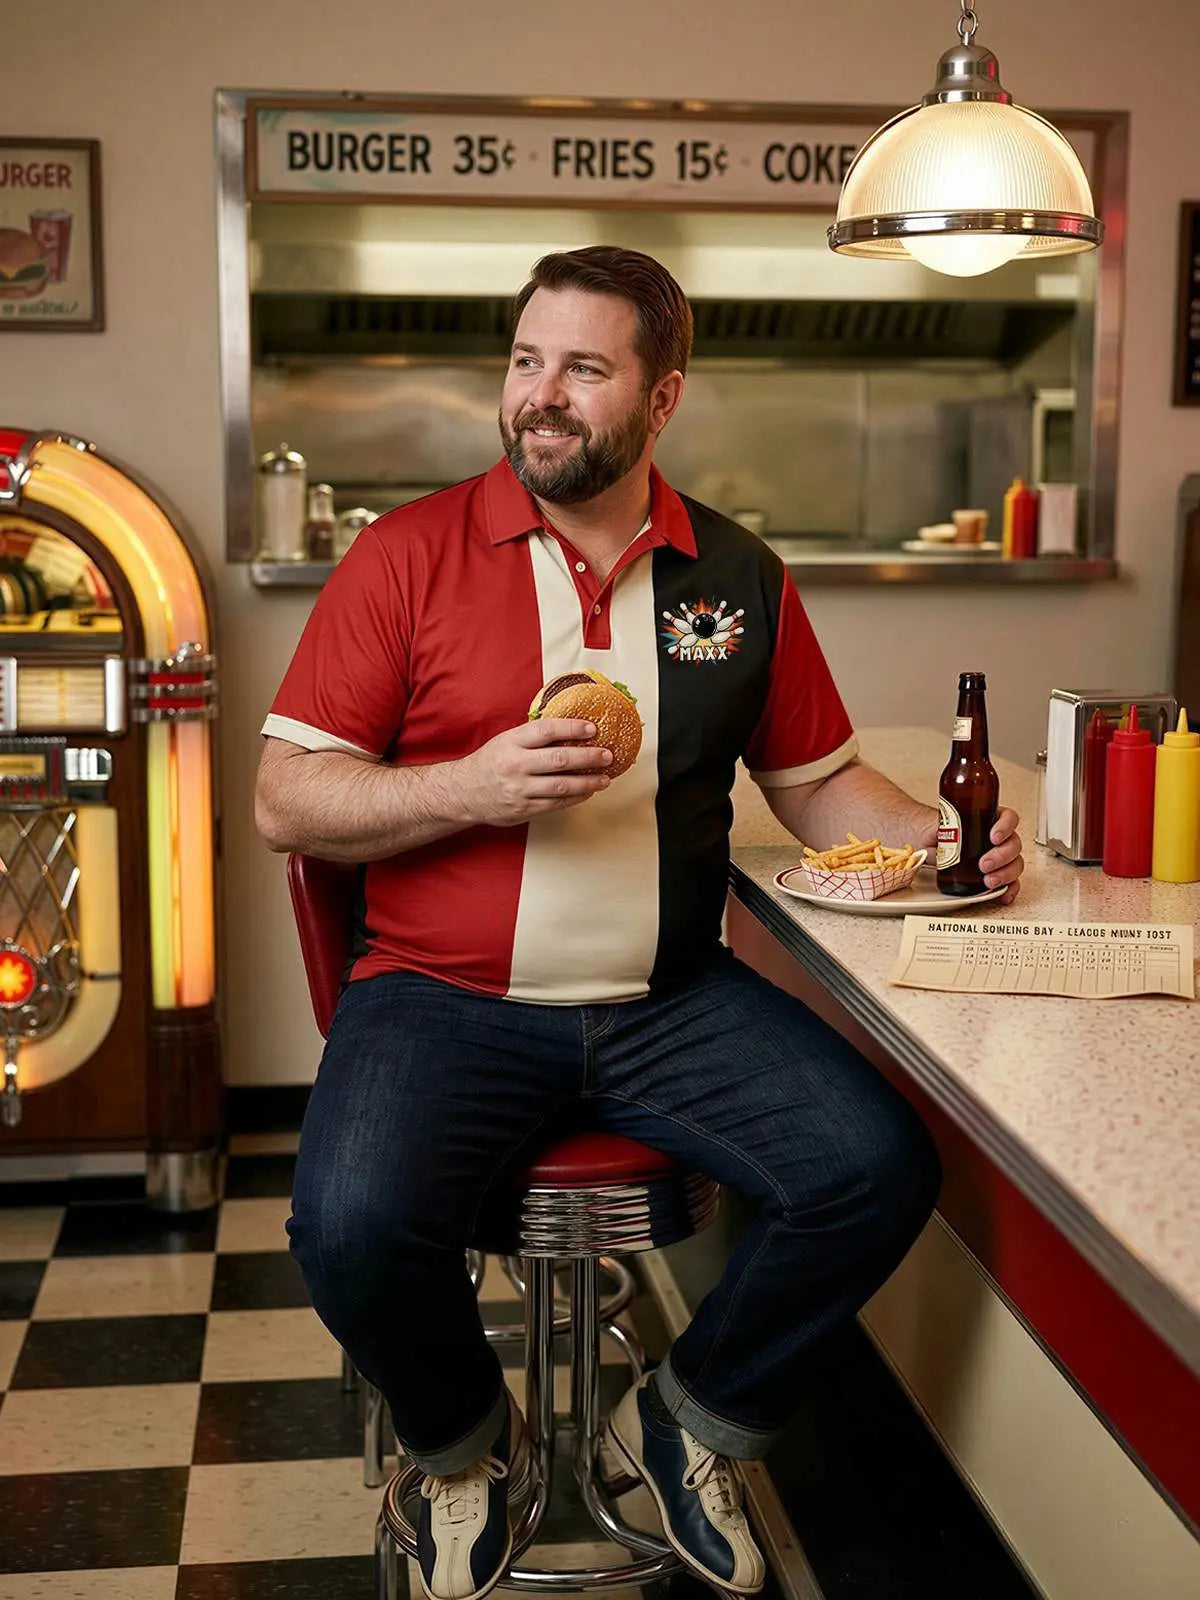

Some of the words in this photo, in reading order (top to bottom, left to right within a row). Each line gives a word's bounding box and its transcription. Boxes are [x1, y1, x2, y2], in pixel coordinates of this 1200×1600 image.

[287, 131, 431, 174] BURGER
[452, 134, 517, 176] 35¢
[552, 137, 655, 179] FRIES
[675, 140, 729, 180] 15¢
[680, 646, 728, 661] MAXX
[1034, 926, 1054, 936] BAY
